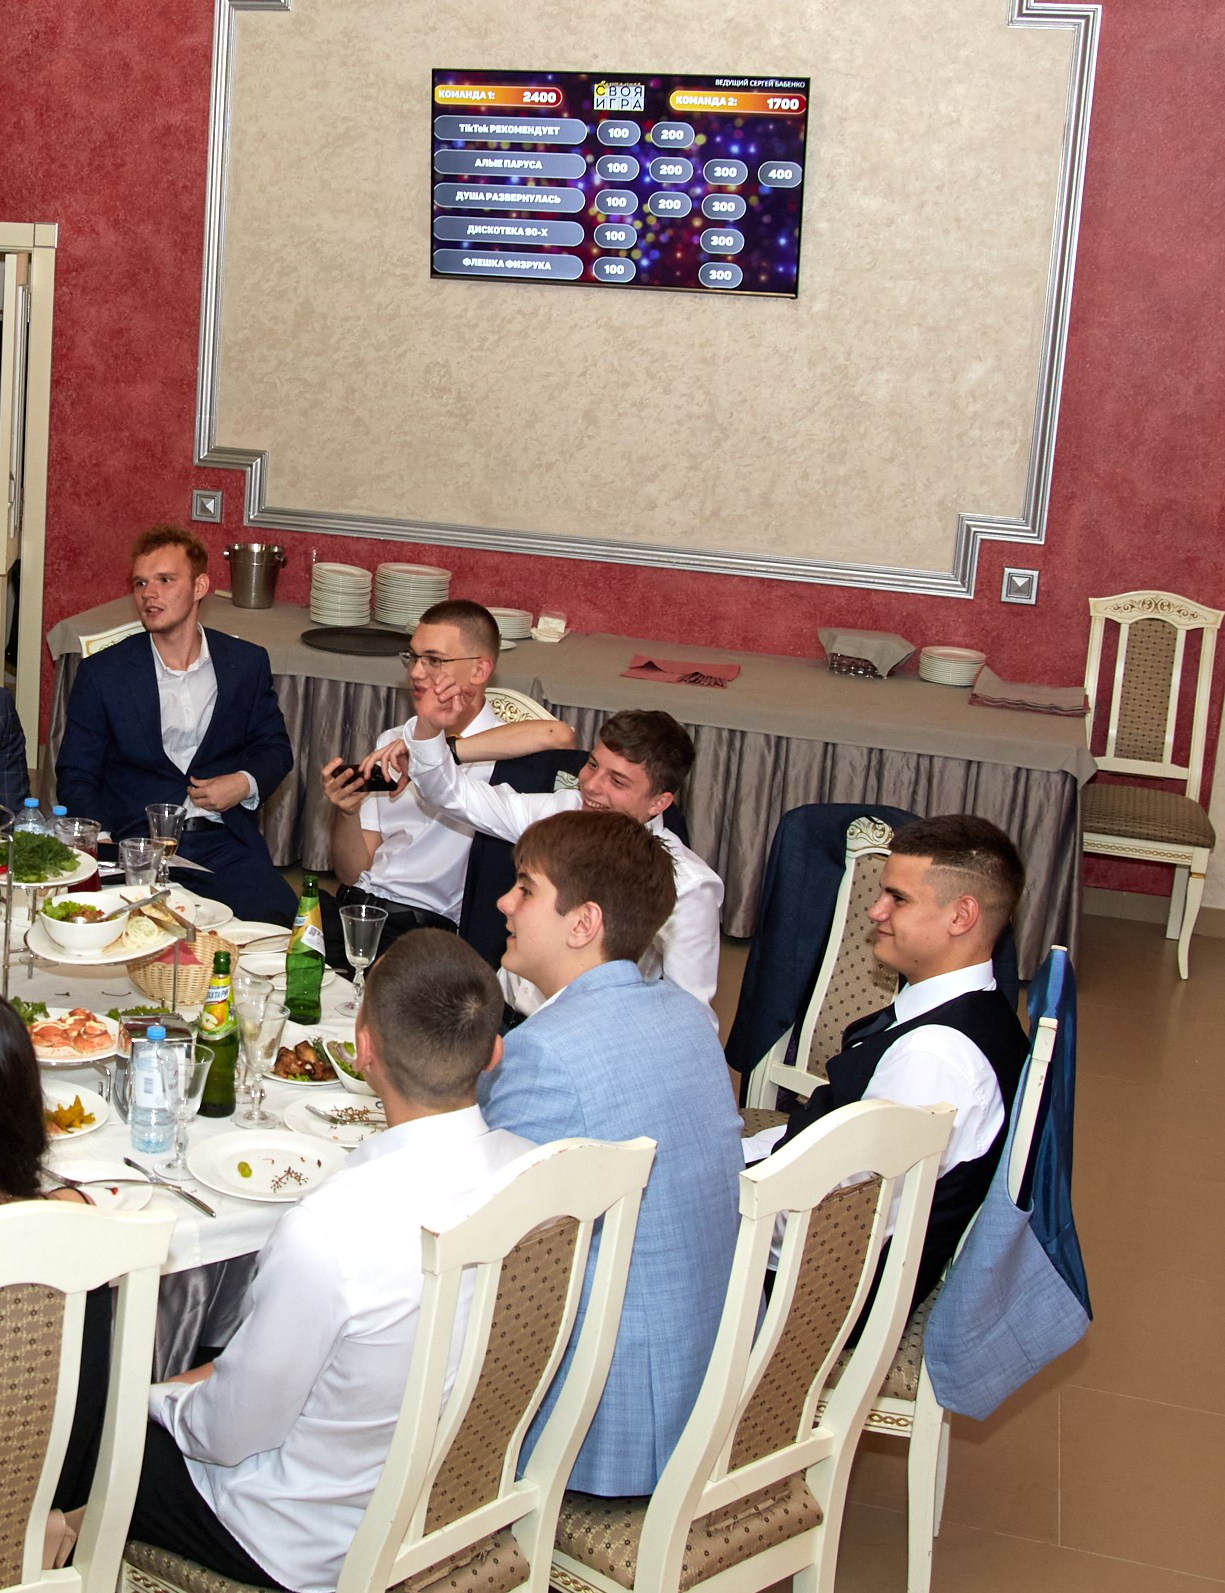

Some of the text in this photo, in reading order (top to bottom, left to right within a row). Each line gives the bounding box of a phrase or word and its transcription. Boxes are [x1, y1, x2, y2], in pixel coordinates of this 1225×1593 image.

[715, 79, 805, 88] ВЕДУЩИЙ СЕРГЕЙ БАБЕНКО
[438, 90, 486, 100] КОМАНДА
[522, 91, 556, 103] 2400
[596, 86, 642, 97] СВОЯ
[596, 98, 642, 110] ИГРА
[676, 96, 800, 110] КОМАНДА 2: 1700
[459, 124, 560, 137] TikTok РЕКОМЕНДУЕТ
[608, 128, 684, 140] 100 200
[475, 159, 542, 170] АЛЫЕ ПАРУСА
[607, 163, 792, 179] 100 200 300 400
[456, 191, 561, 204] ДУША РАЗВЕРНУЛАСЬ
[606, 197, 735, 212] 100 200 300
[467, 225, 524, 236] ДИСКОТЕКА
[605, 231, 734, 246] 100 300
[462, 258, 551, 270] ФЛЕШКА ФИЗРУКА
[604, 265, 732, 280] 100 300
